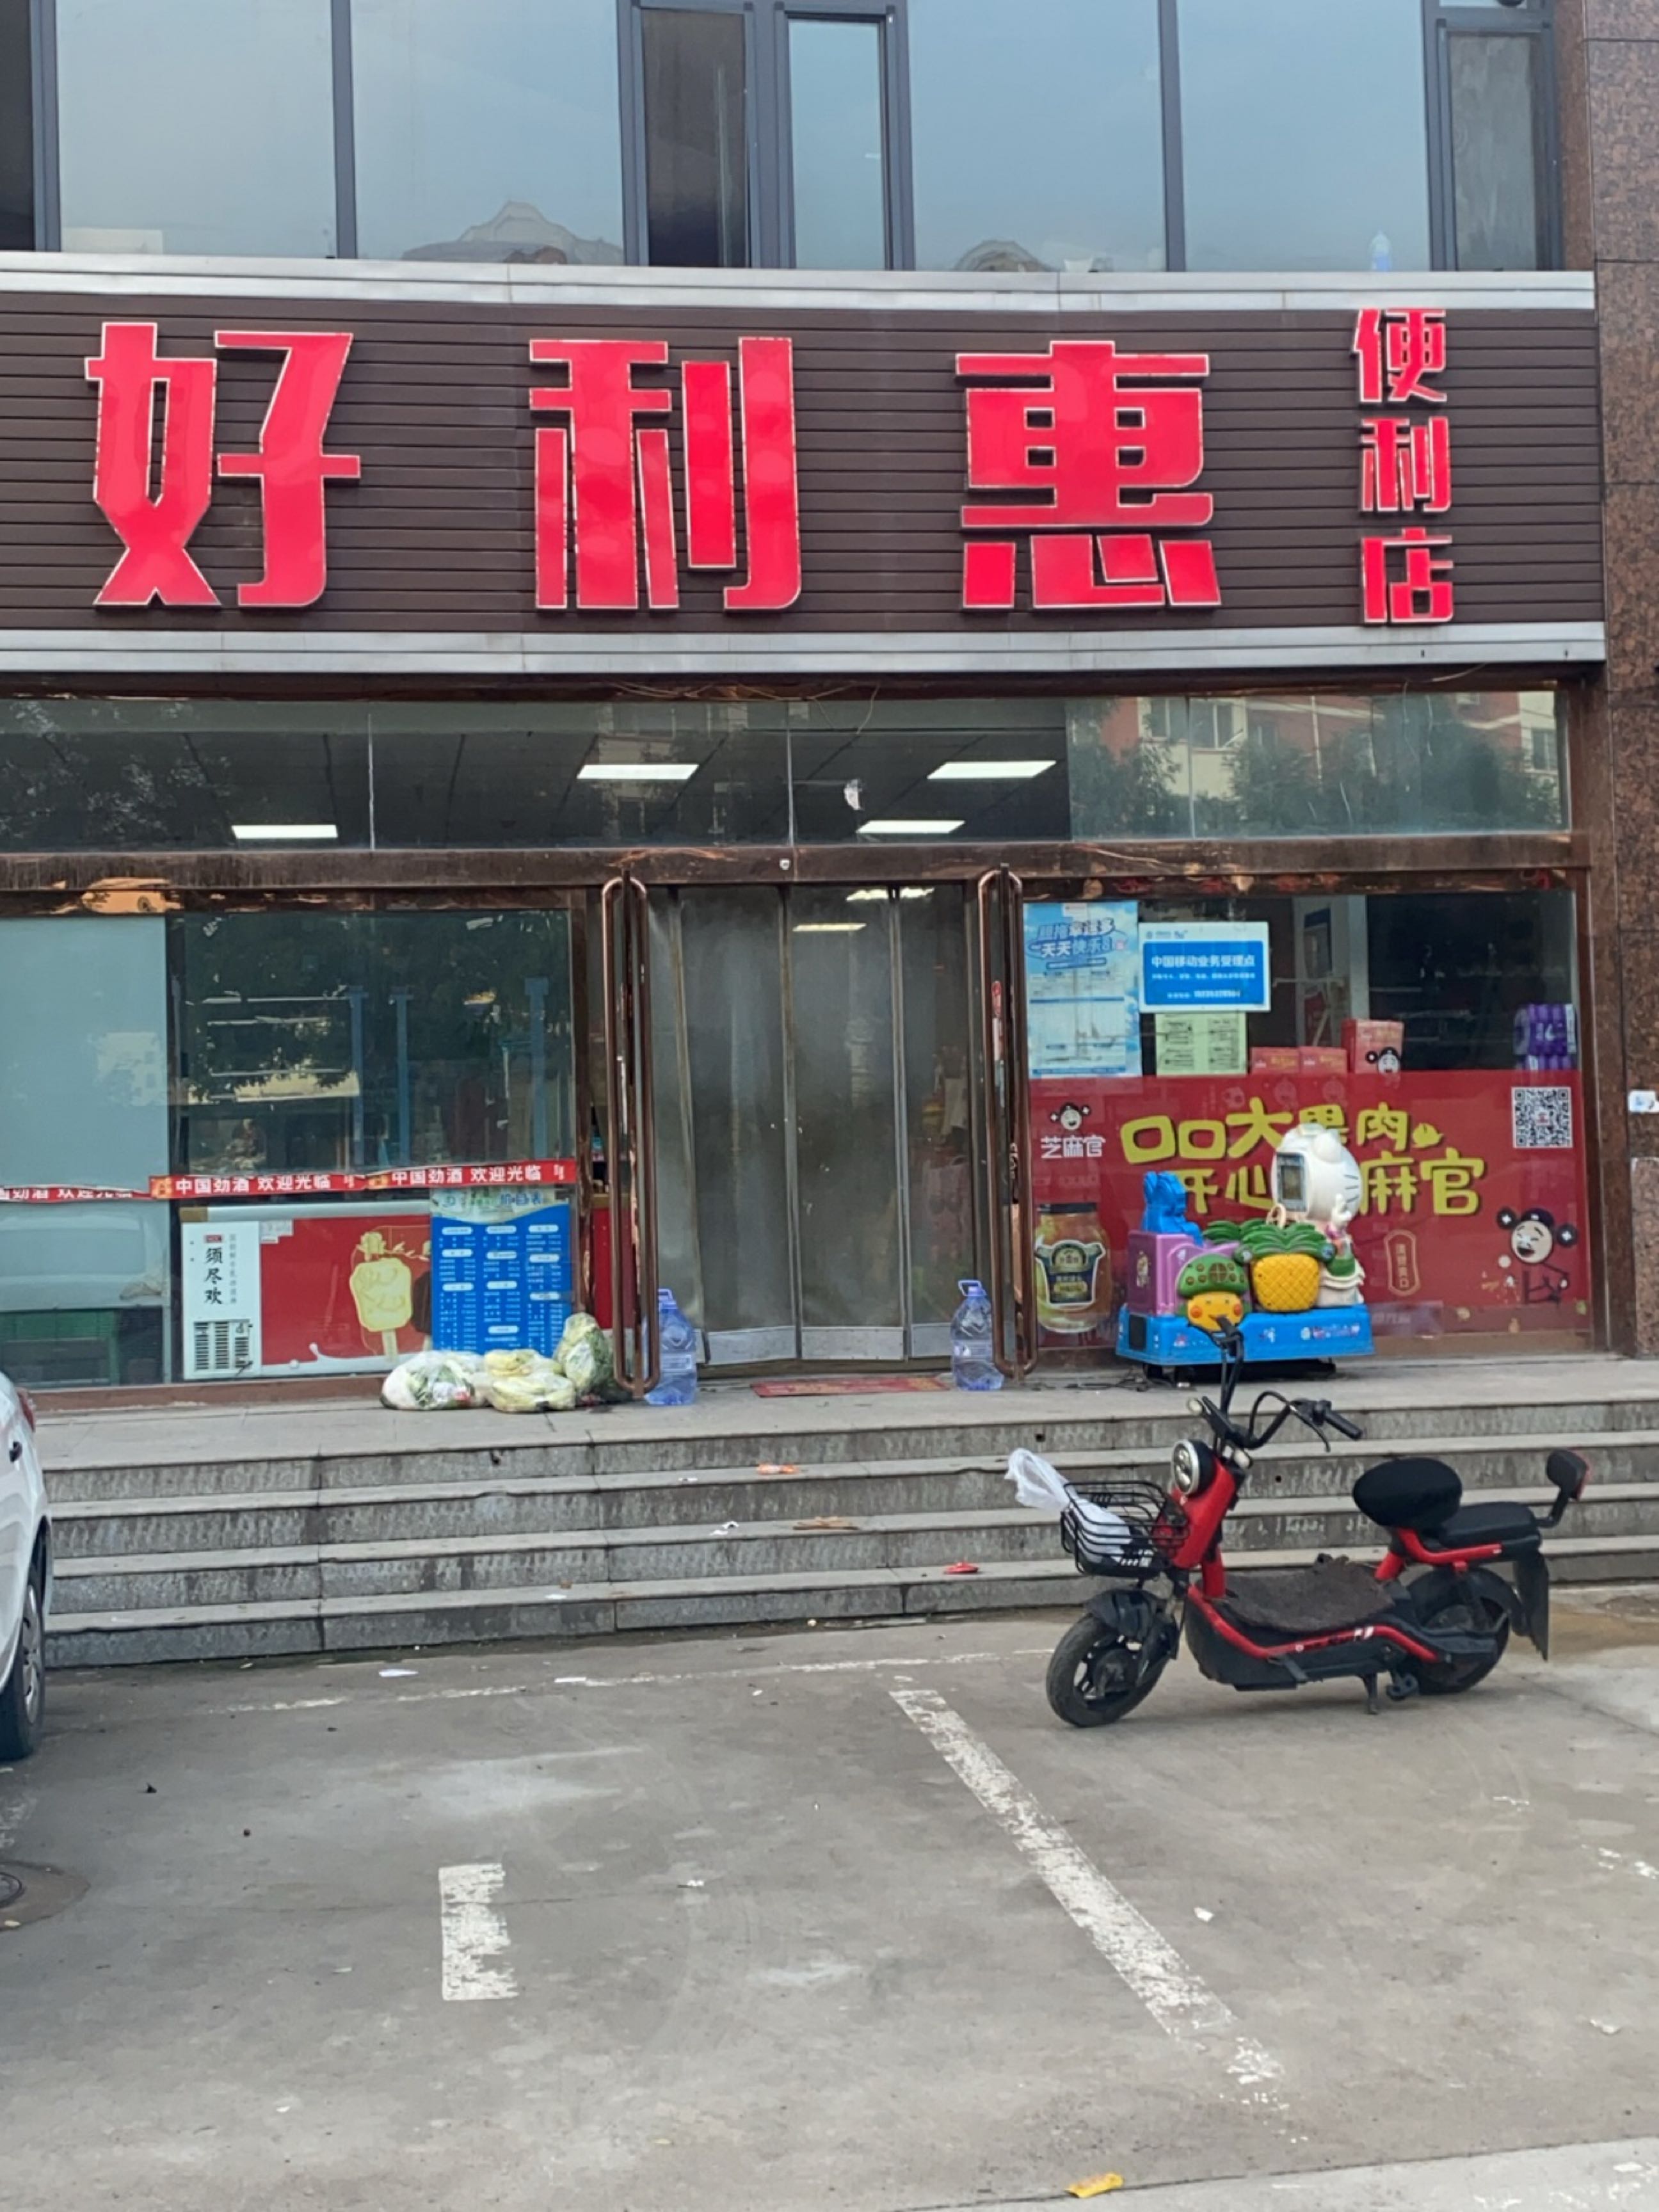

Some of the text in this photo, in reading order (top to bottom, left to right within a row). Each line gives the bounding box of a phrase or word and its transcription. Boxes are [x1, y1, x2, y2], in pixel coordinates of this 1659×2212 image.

[84, 320, 1222, 611] 好利惠
[1350, 309, 1454, 624] 便利店
[391, 1167, 463, 1185] 中国劲酒
[470, 1164, 541, 1183] 欢迎光临
[1040, 1134, 1107, 1158] 芝麻官
[175, 1177, 250, 1195] 中国劲酒
[257, 1174, 332, 1191] 欢迎光临
[1167, 1146, 1485, 1215] 开心麻官
[204, 1247, 223, 1305] 须尽欢
